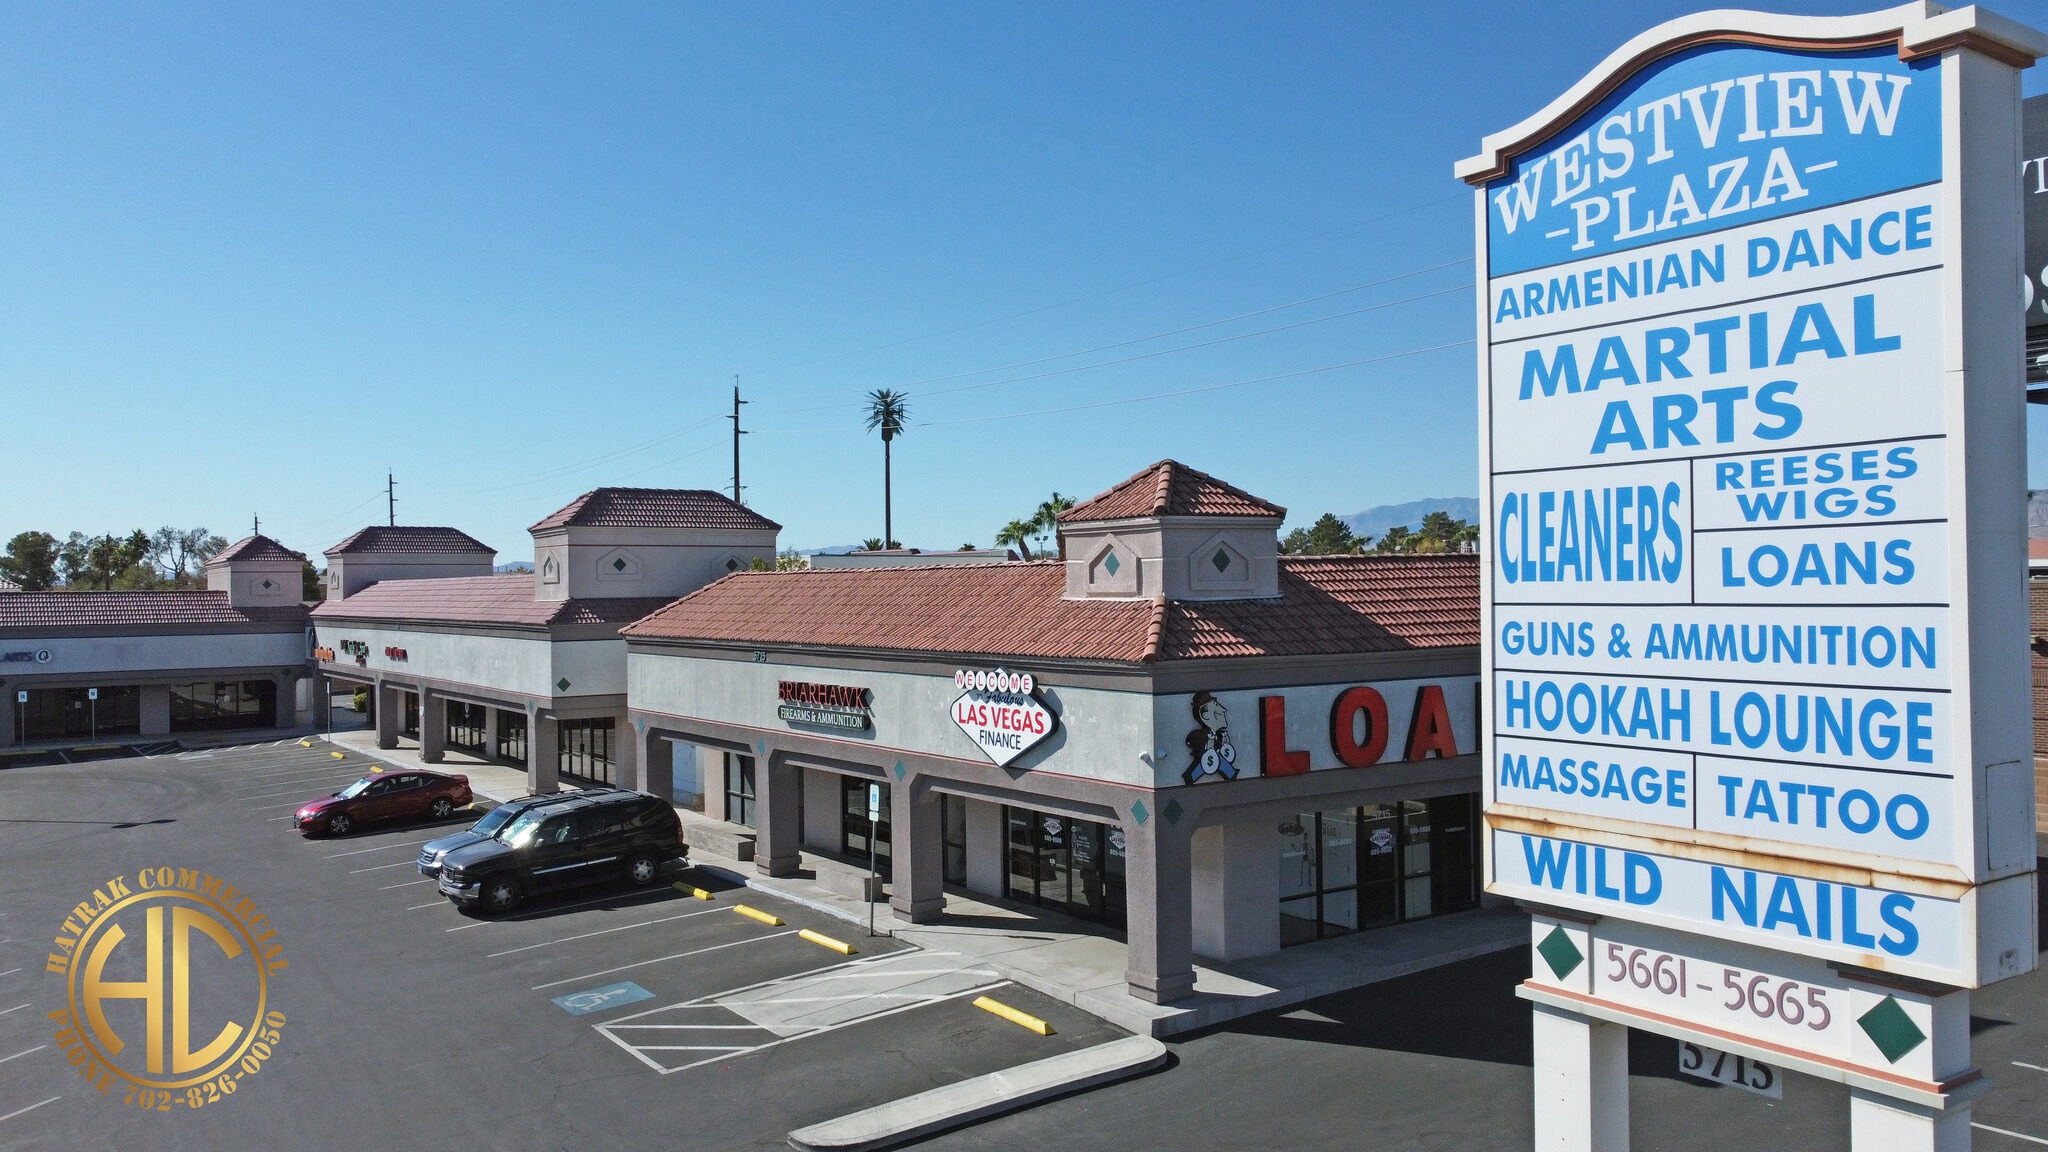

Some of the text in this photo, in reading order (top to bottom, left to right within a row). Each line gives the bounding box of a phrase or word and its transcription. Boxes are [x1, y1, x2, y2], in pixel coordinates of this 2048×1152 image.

[1495, 71, 1911, 235] WESTVIEW
[1496, 205, 1932, 323] ARMENIAN DANCE
[1519, 294, 1901, 400] MARTIAL
[1591, 381, 1802, 454] ARTS
[1716, 447, 1917, 490] REESES
[1737, 485, 1896, 522] WIGS
[1500, 482, 1683, 584] CLEANERS
[1722, 540, 1914, 587] LOANS
[1502, 621, 1936, 669] GUNS & AMMUNITION
[778, 680, 865, 709] BRIARHAWK
[956, 672, 1031, 692] WELCOME
[781, 707, 863, 728] FIREARMS & AMMUNITION
[959, 703, 1045, 735] LAS VEGAS
[980, 730, 1022, 750] FINANCE
[1259, 681, 1481, 777] LOA
[1507, 680, 1933, 763] HOOKAH LOUNGE
[1500, 754, 1686, 808] MASSAGE
[1717, 776, 1930, 840] TATTOO
[1522, 836, 1920, 956] WILD NAILS
